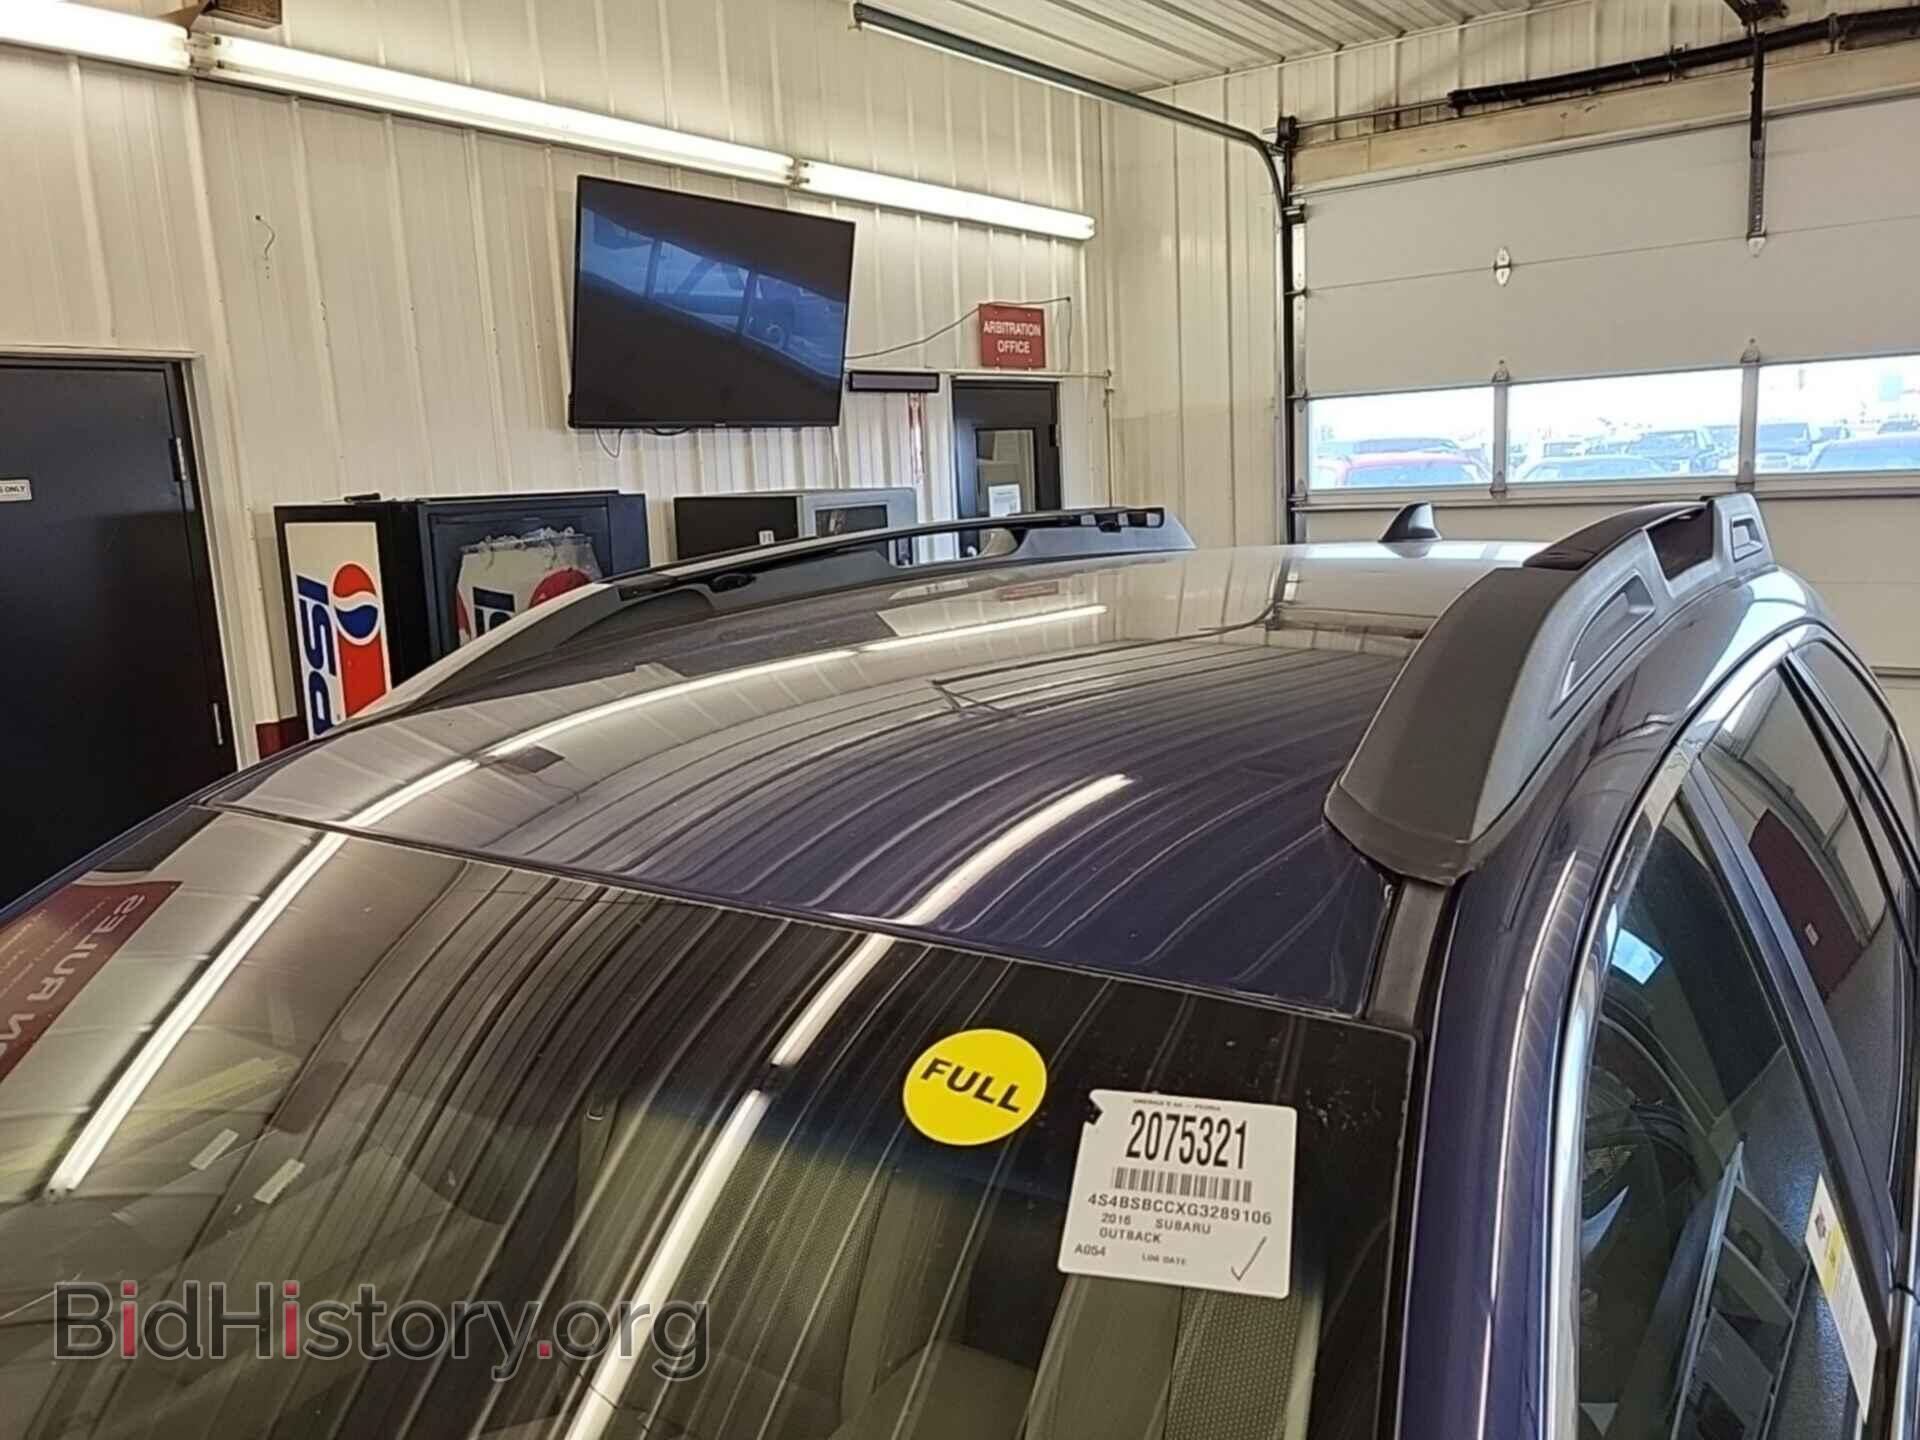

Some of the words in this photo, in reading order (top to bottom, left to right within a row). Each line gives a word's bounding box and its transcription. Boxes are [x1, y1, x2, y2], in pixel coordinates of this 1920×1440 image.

[983, 320, 1042, 337] ARBITRATION
[997, 340, 1031, 354] OFFICE
[296, 574, 337, 736] PSI
[920, 1057, 1021, 1113] FULL
[1125, 1109, 1247, 1169] 2075321
[1087, 1193, 1273, 1225] 4S4BSBCCXG3289106
[1099, 1227, 1161, 1244] OUTBACK
[1100, 1212, 1132, 1225] 2016
[1155, 1218, 1212, 1235] SUBARU
